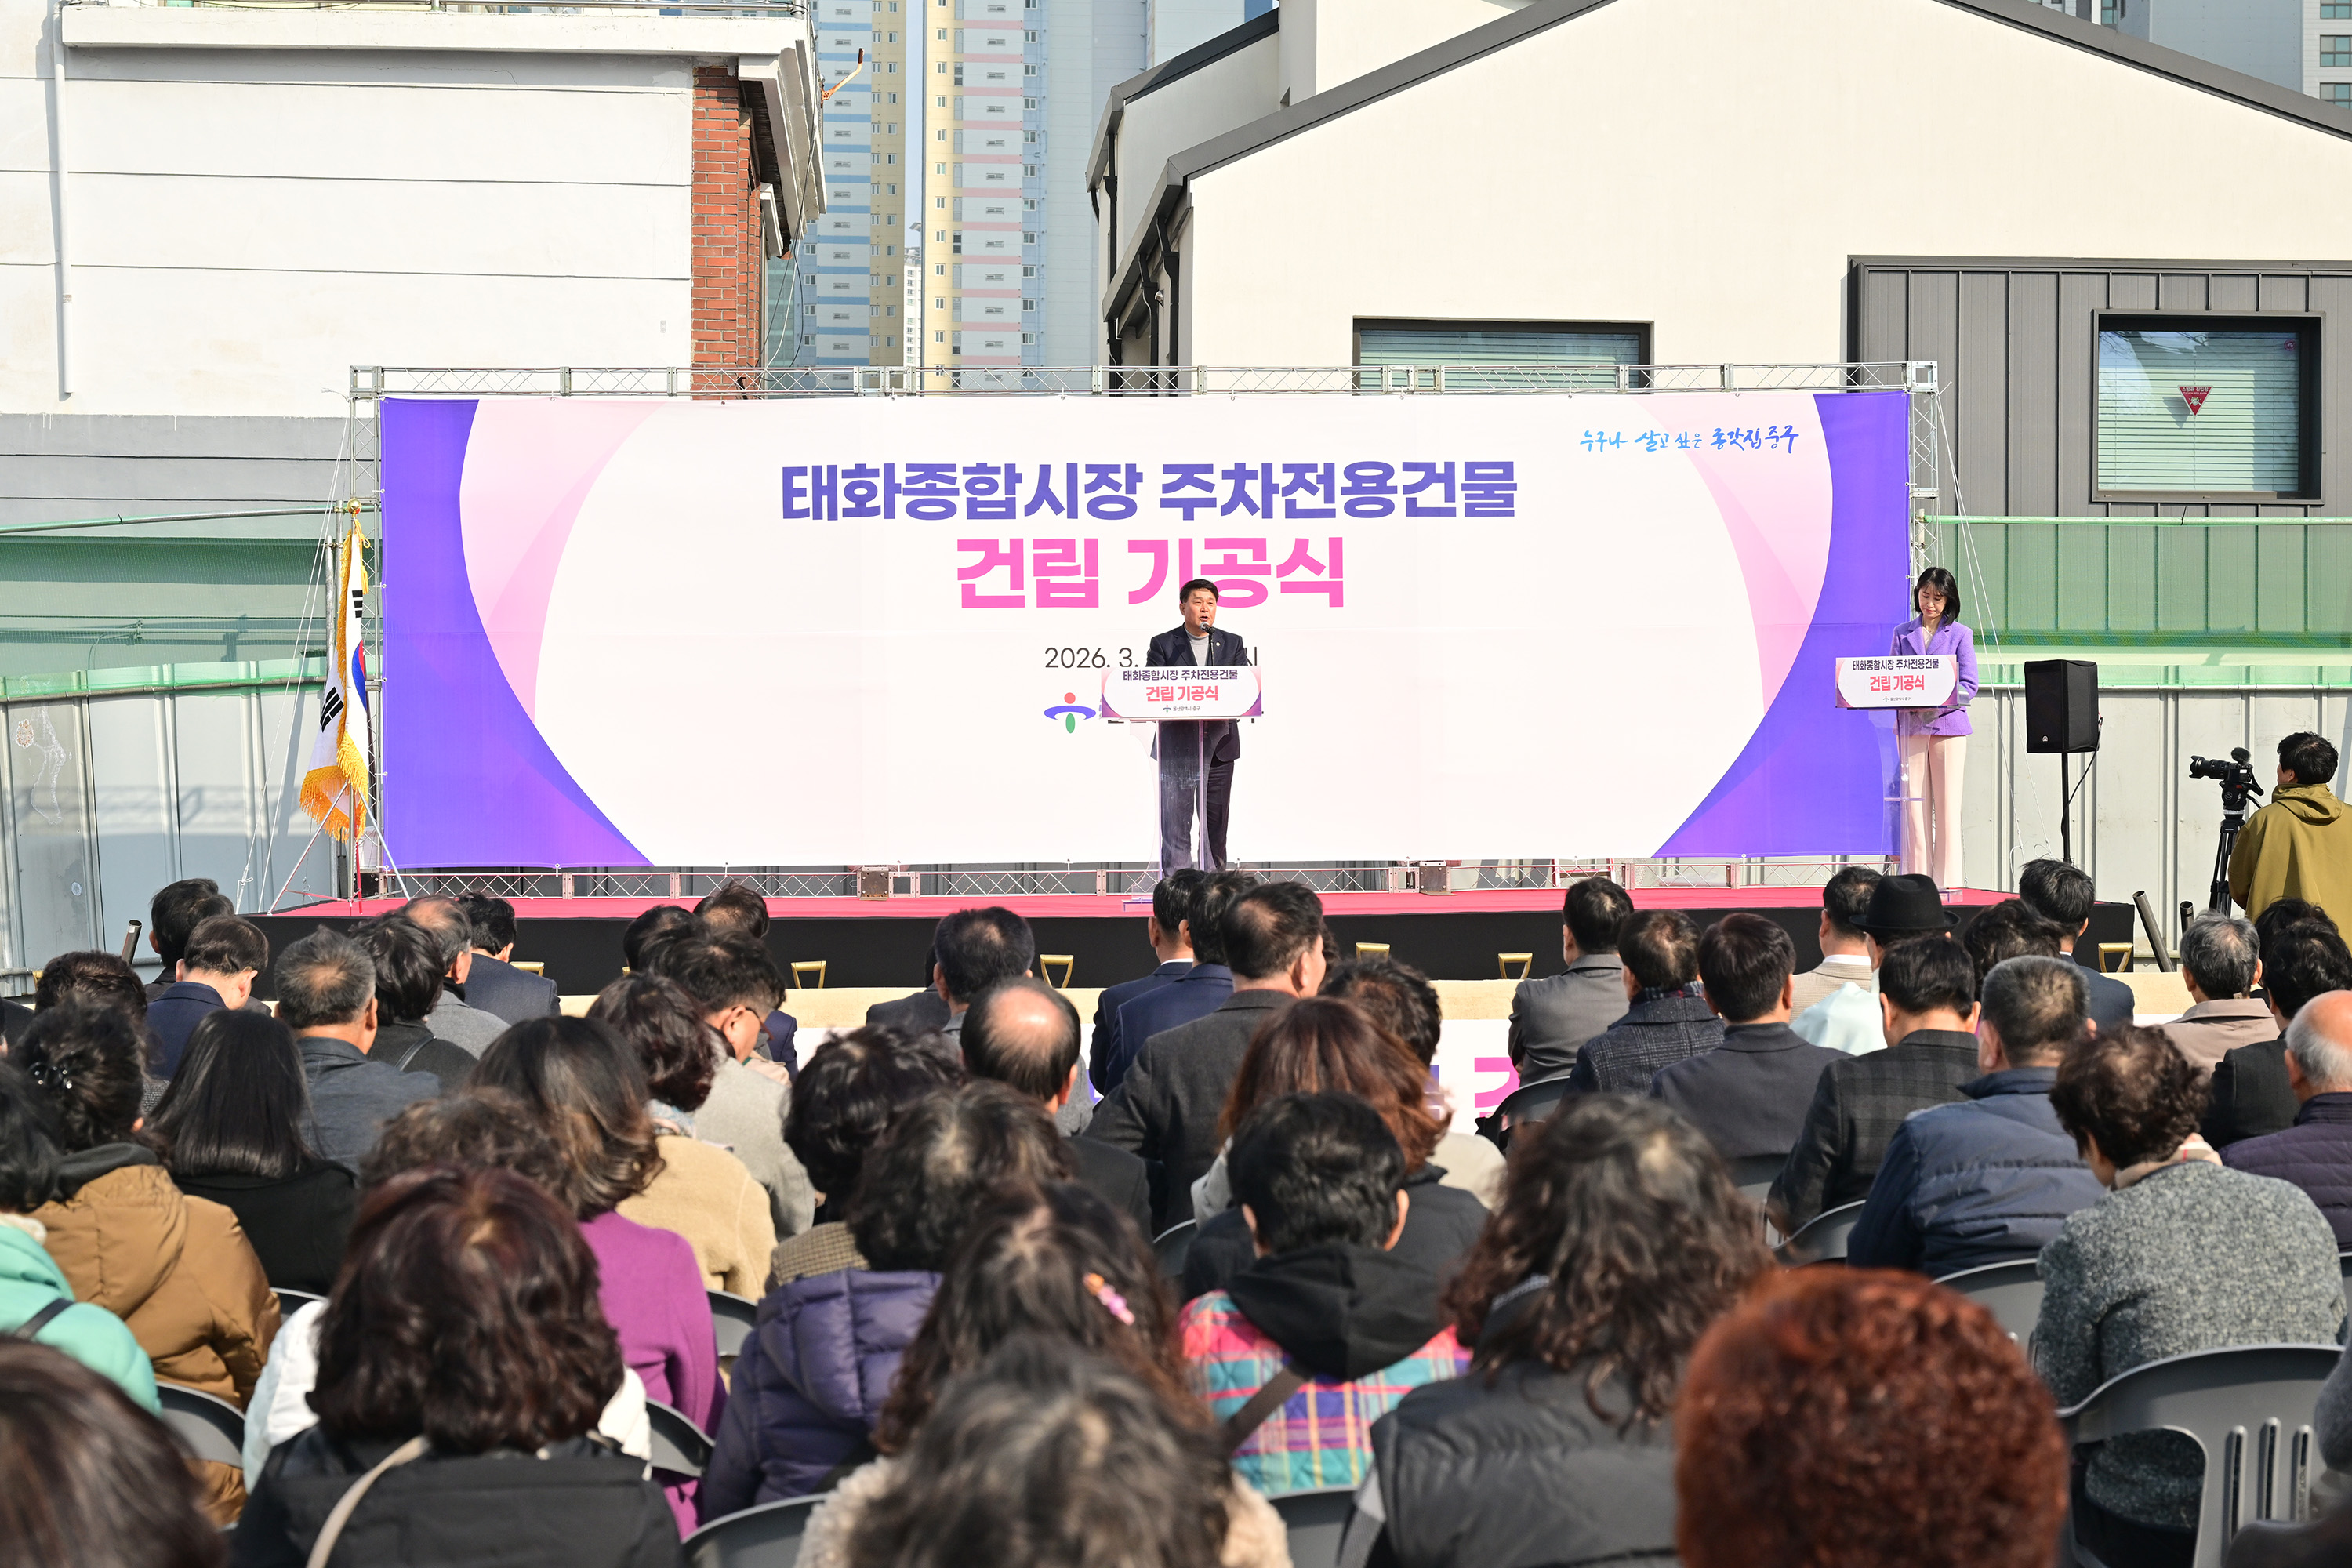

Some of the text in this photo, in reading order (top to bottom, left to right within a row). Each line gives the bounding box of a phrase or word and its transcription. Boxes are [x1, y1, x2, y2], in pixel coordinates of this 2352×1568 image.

[1580, 425, 1799, 454] 누구나 살고 싶은 종갓집 중구
[782, 460, 1518, 521] 태화종합시장 주차전용건물
[957, 536, 1344, 608] 건립 기공식
[1045, 647, 1111, 669] 2026.
[1119, 647, 1138, 667] 3.
[1852, 658, 1940, 670] 태화종합시장 주차전용건물
[1123, 669, 1238, 681] 태화종합시장 주차전용건물
[1870, 674, 1925, 691] 건립 기공식
[1146, 685, 1218, 702] 건립 기공식
